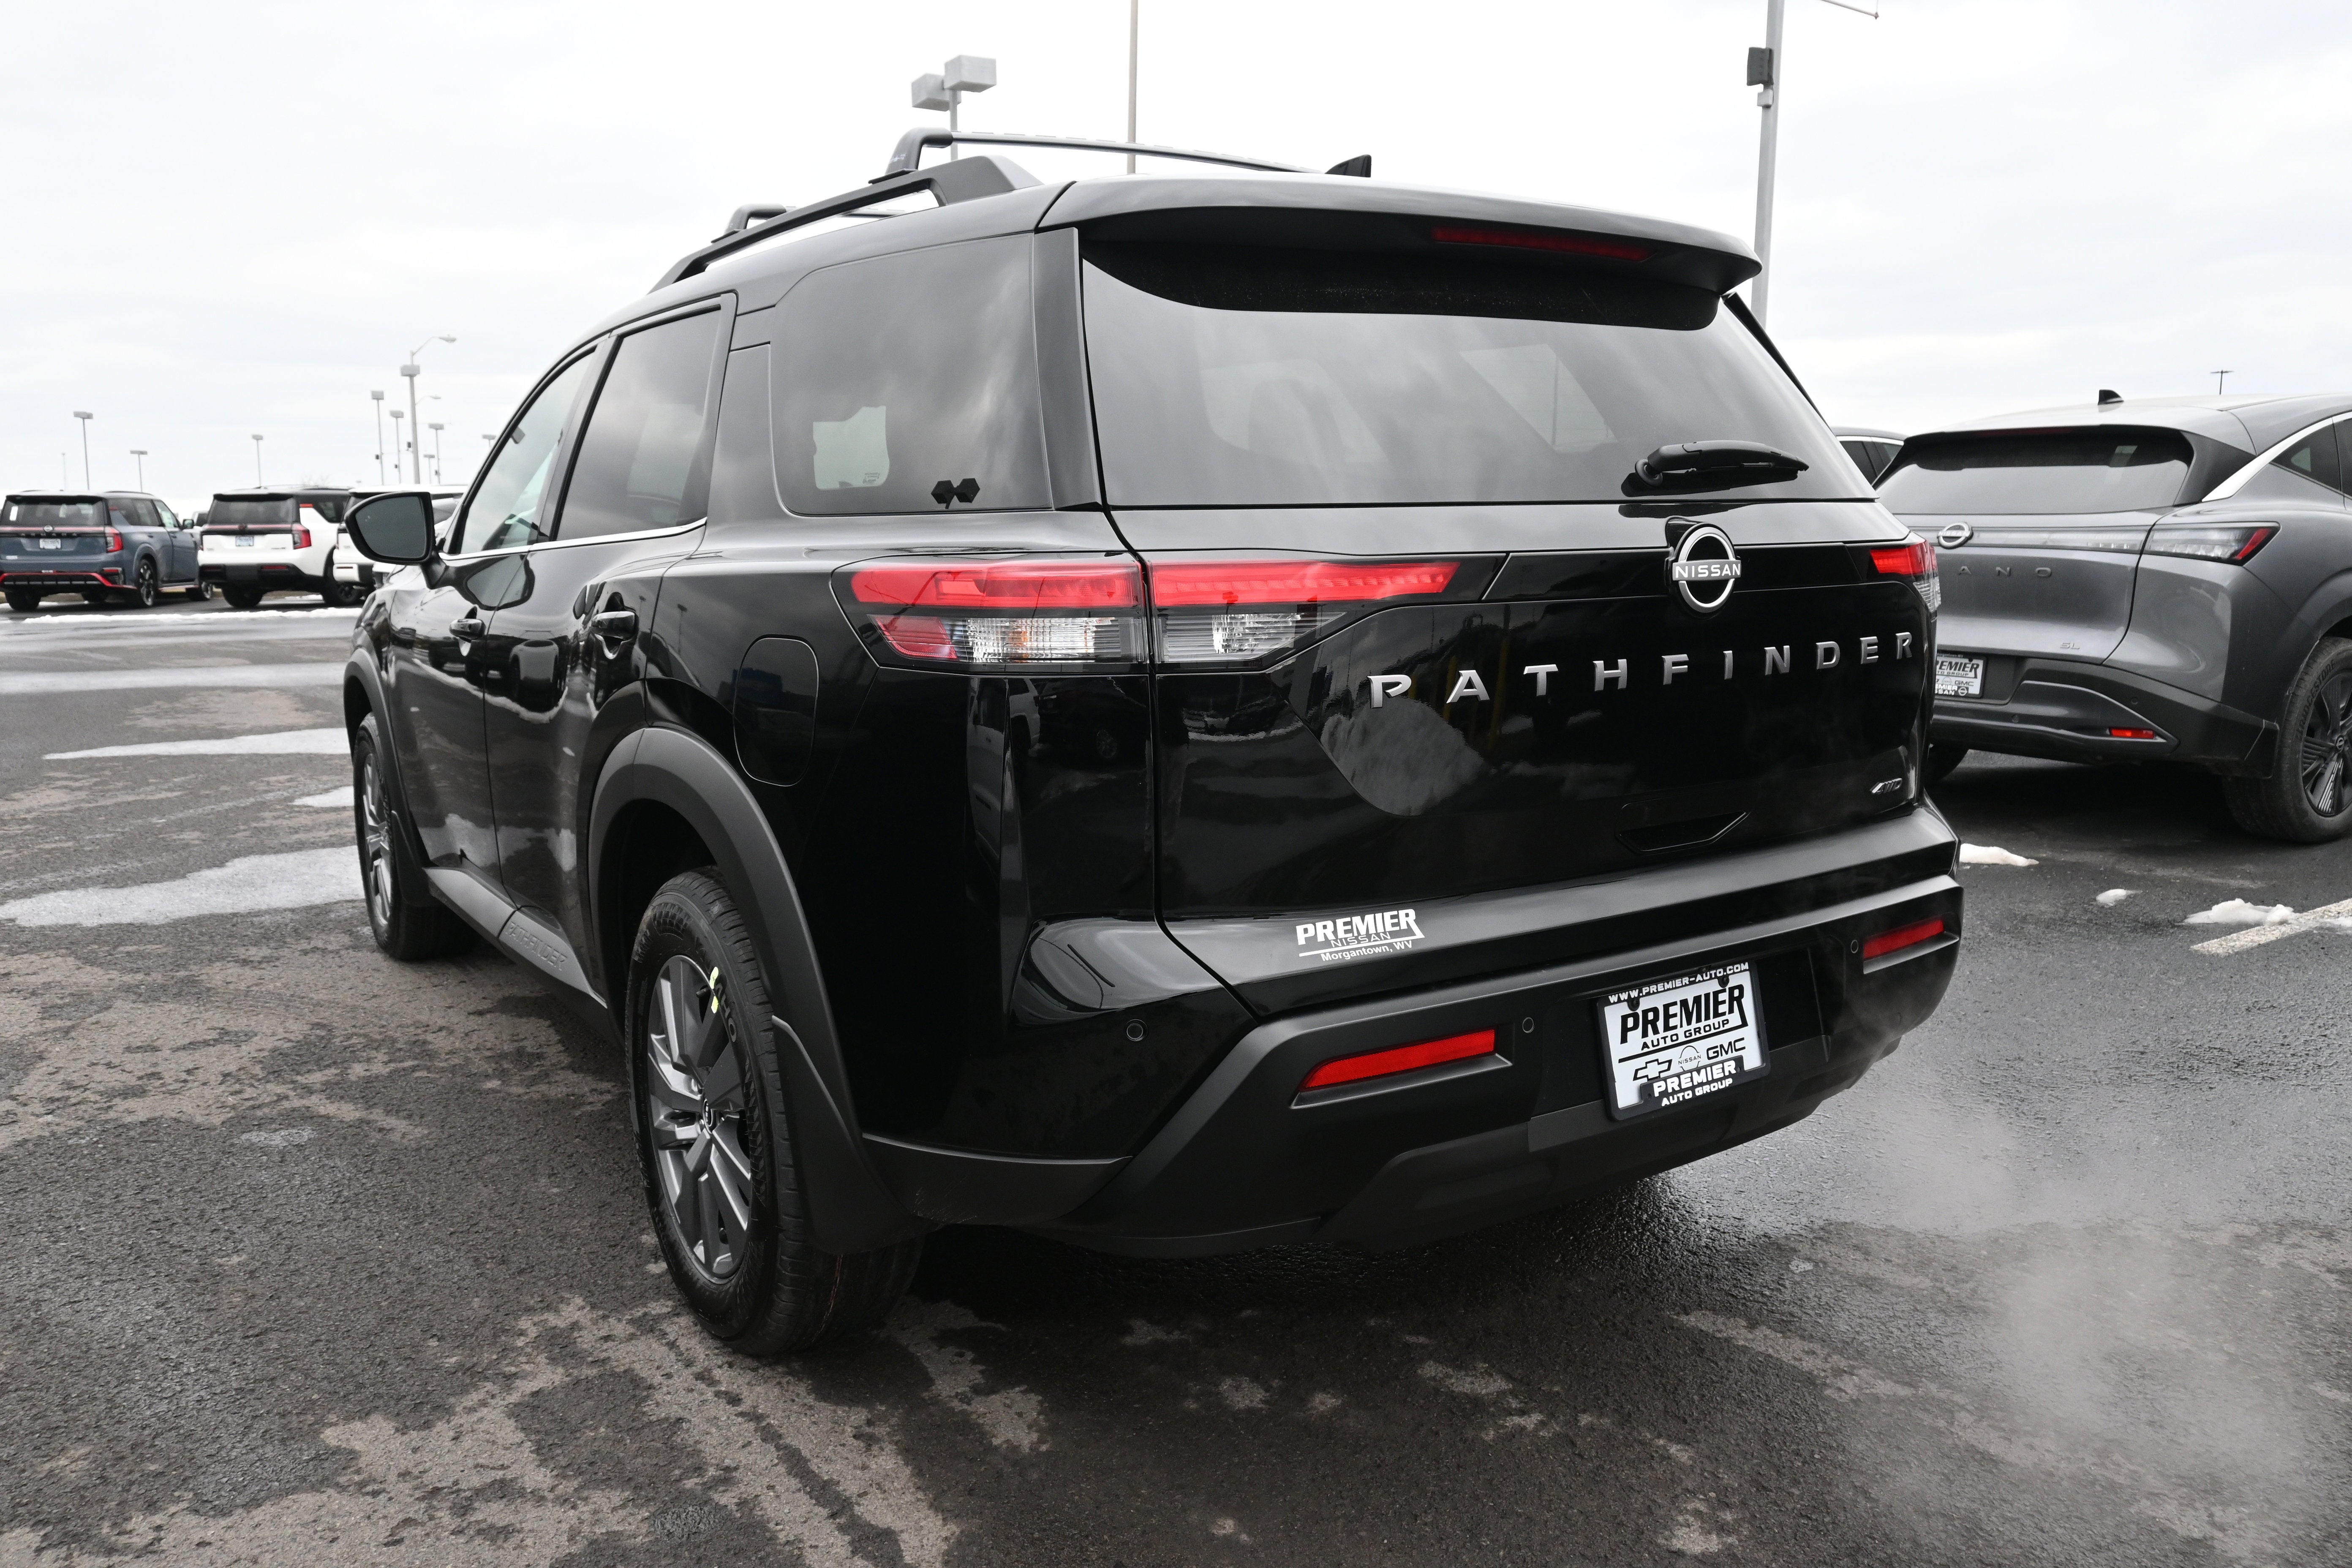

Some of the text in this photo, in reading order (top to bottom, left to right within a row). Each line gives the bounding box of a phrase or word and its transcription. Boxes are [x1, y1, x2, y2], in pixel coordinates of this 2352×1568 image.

[1675, 563, 1740, 578] NISSAN
[2060, 642, 2080, 650] SL
[1367, 631, 1913, 708] PATHFINDER
[1296, 909, 1423, 945] PREMIER
[1330, 931, 1391, 948] NISSAN
[505, 921, 568, 971] PATHFINDER
[1320, 940, 1413, 961] Morgantown, WV
[1608, 962, 1749, 1004] WWW.PREMIER-AUTO.COM
[1620, 984, 1748, 1045] PREMIER
[1641, 1018, 1730, 1051] AUTO GROUP
[1678, 1037, 1746, 1065] NISSAN GMC
[1653, 1060, 1737, 1097] PREMIER
[1661, 1078, 1733, 1107] AUTO GROUP
